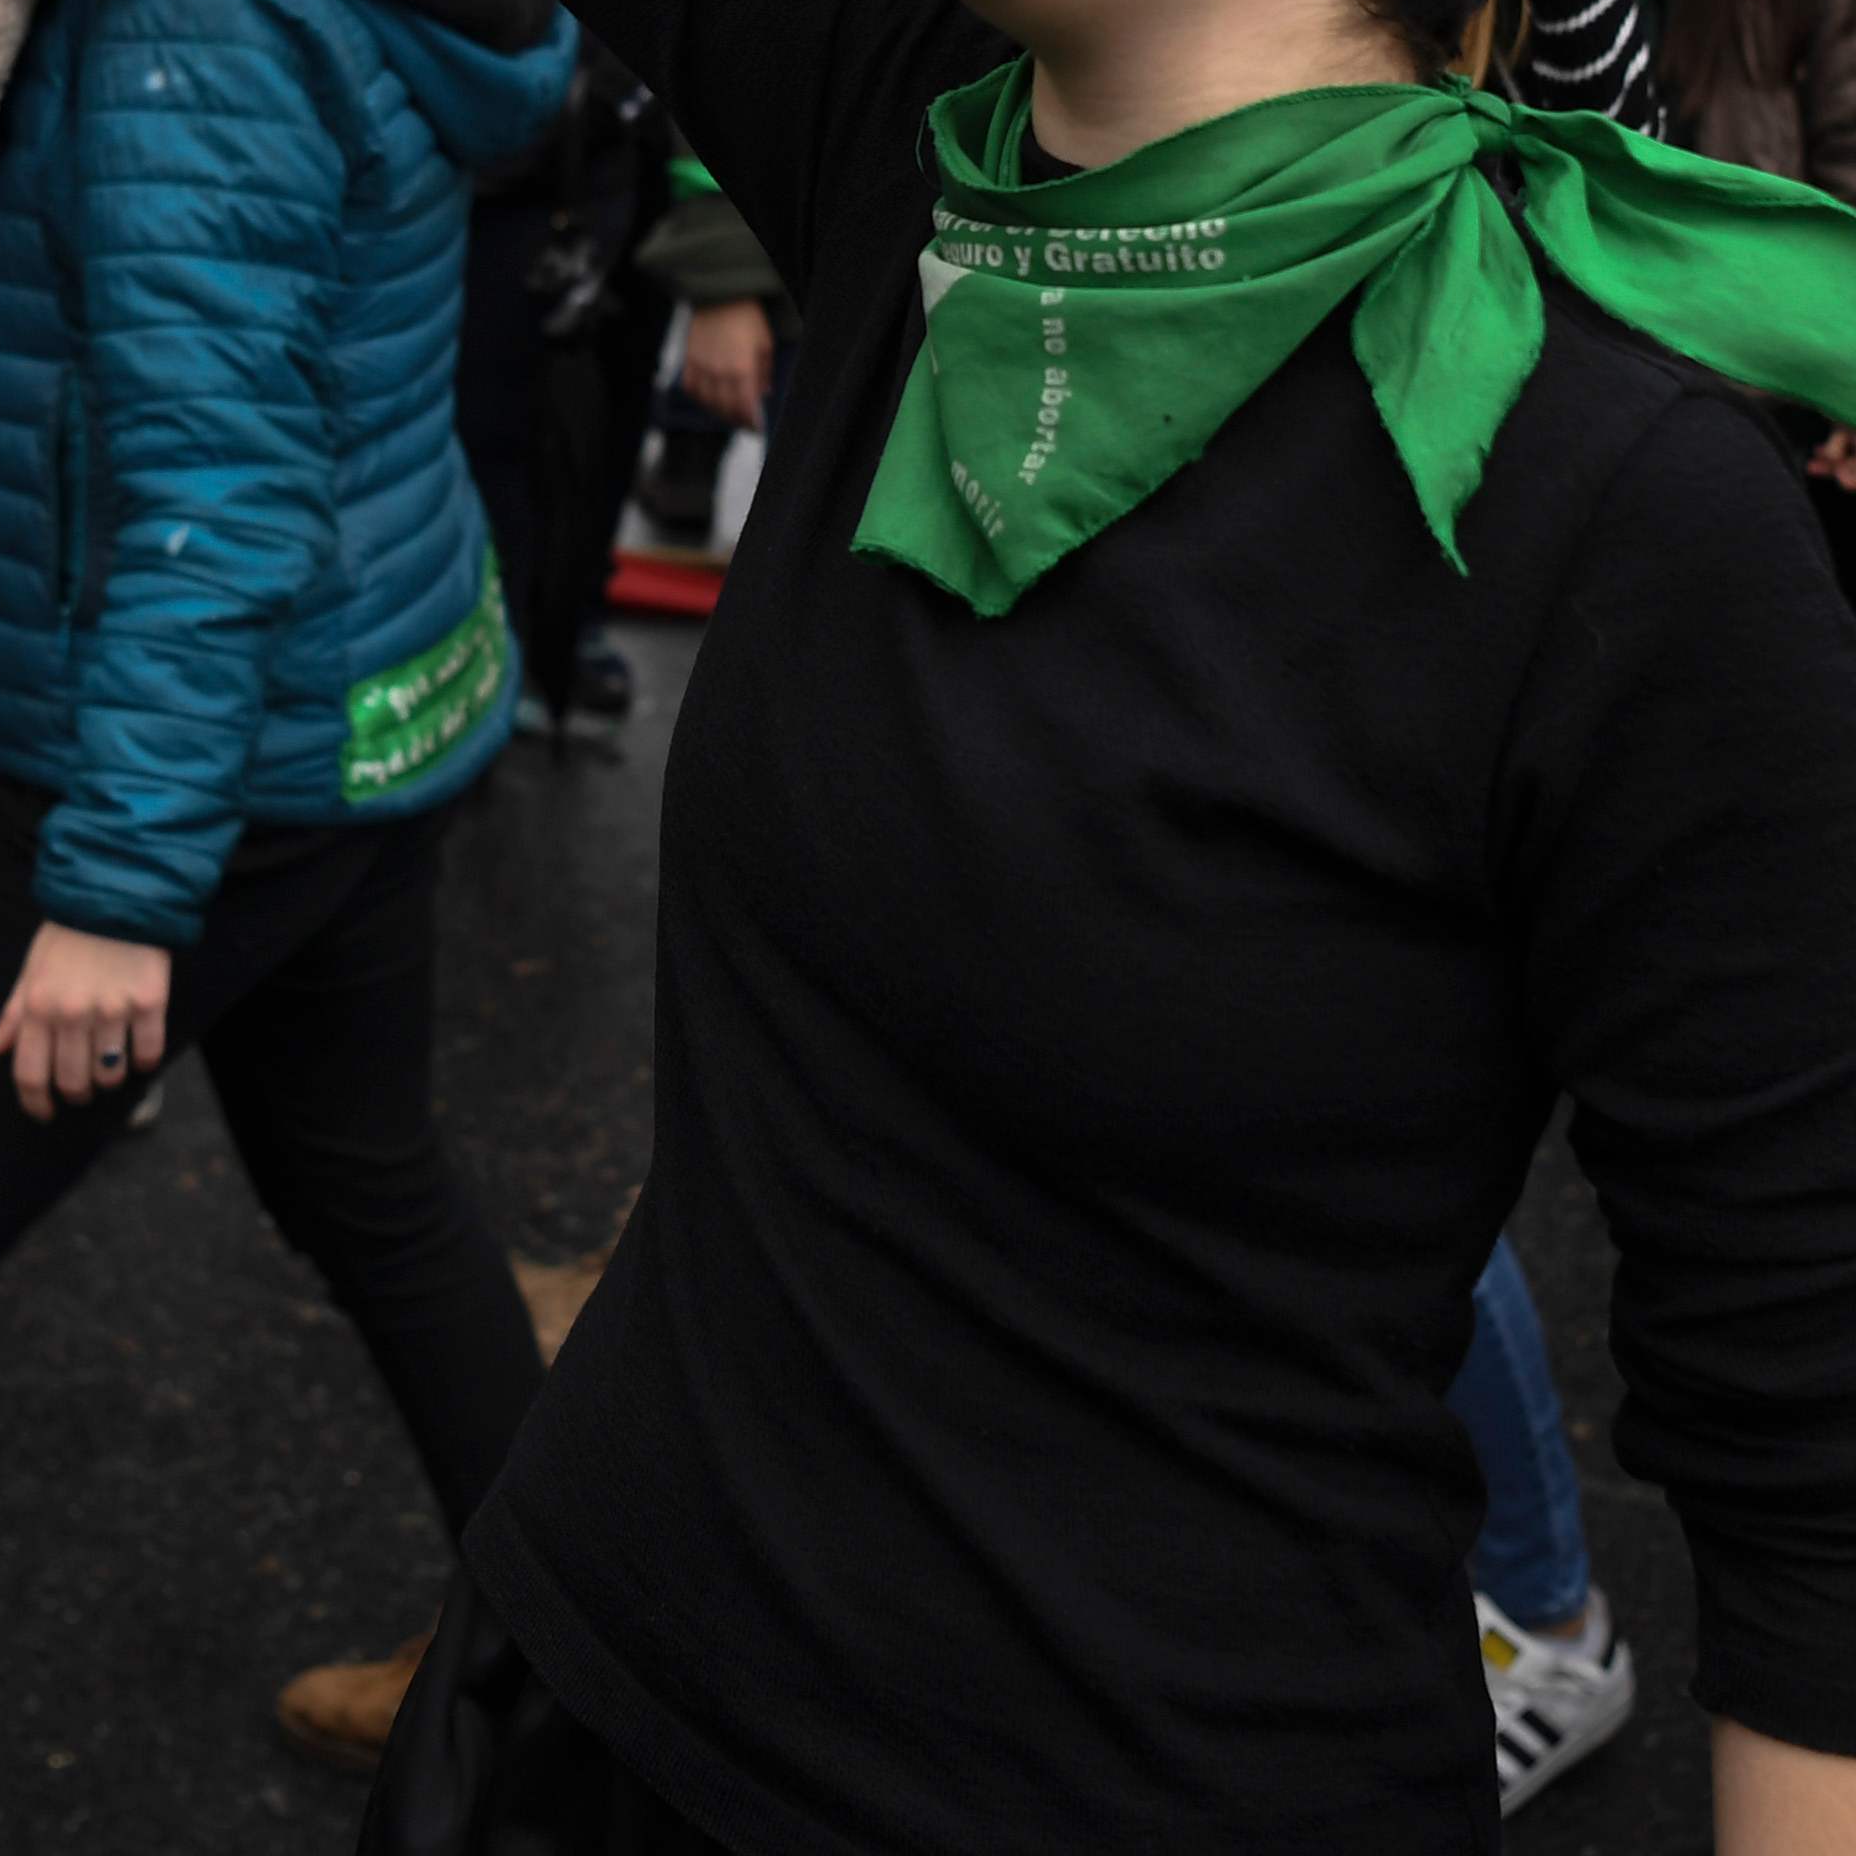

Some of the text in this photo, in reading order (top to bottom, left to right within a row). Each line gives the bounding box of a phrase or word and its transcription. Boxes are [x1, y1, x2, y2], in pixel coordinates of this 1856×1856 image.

[1014, 243, 1032, 276] y
[1045, 241, 1227, 275] Gratuito
[1018, 365, 1074, 487] abortar
[950, 458, 1007, 540] morir
